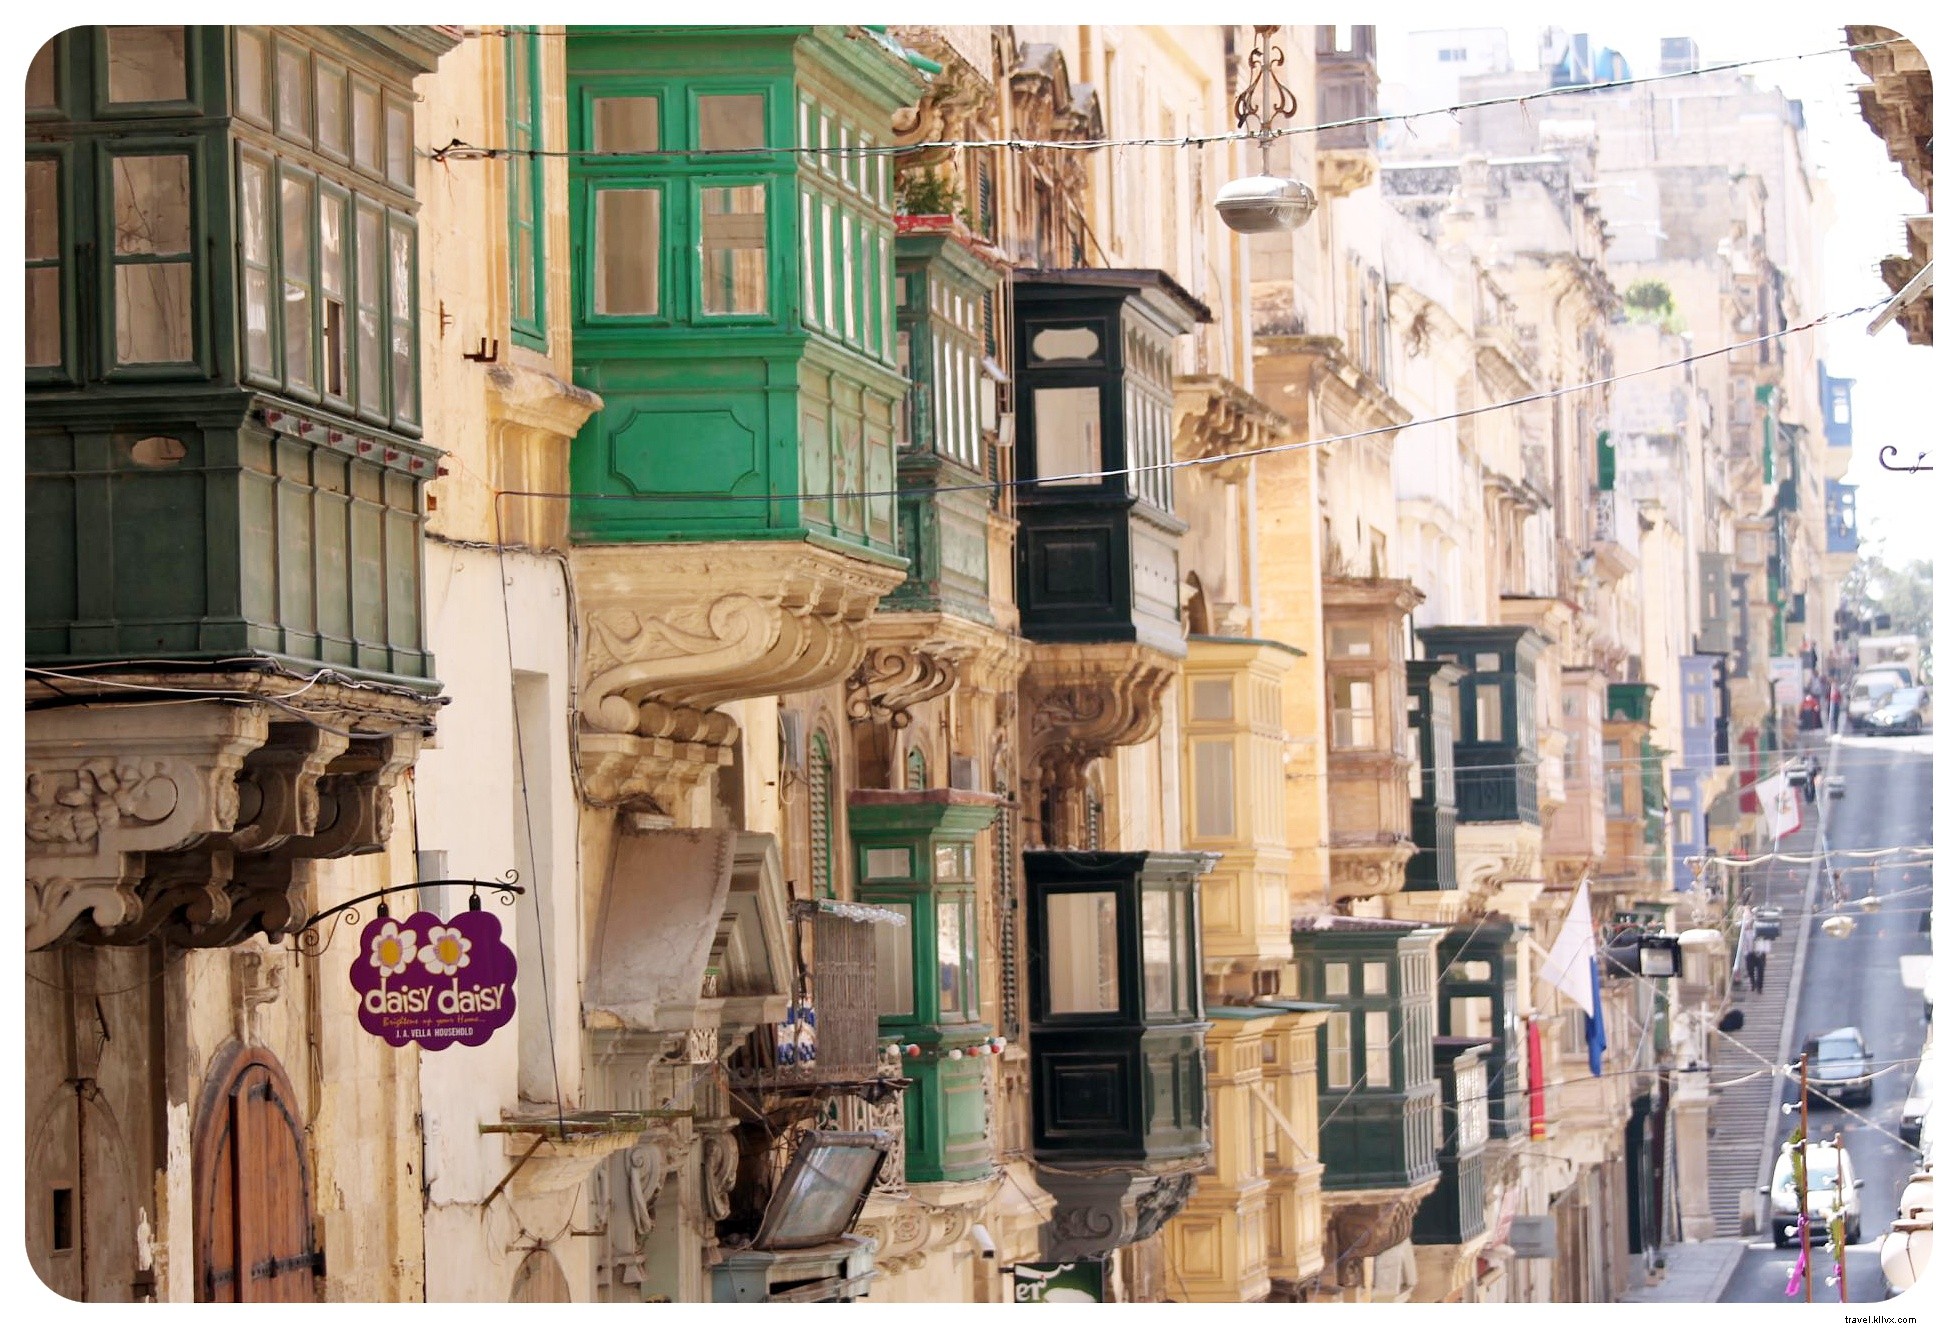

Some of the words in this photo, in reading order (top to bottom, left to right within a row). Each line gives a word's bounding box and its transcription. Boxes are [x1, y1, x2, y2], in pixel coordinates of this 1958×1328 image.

[365, 977, 433, 1014] daisy
[437, 977, 506, 1015] daisy
[411, 1028, 432, 1038] VELLA
[434, 1027, 474, 1037] HOUSEHOLD
